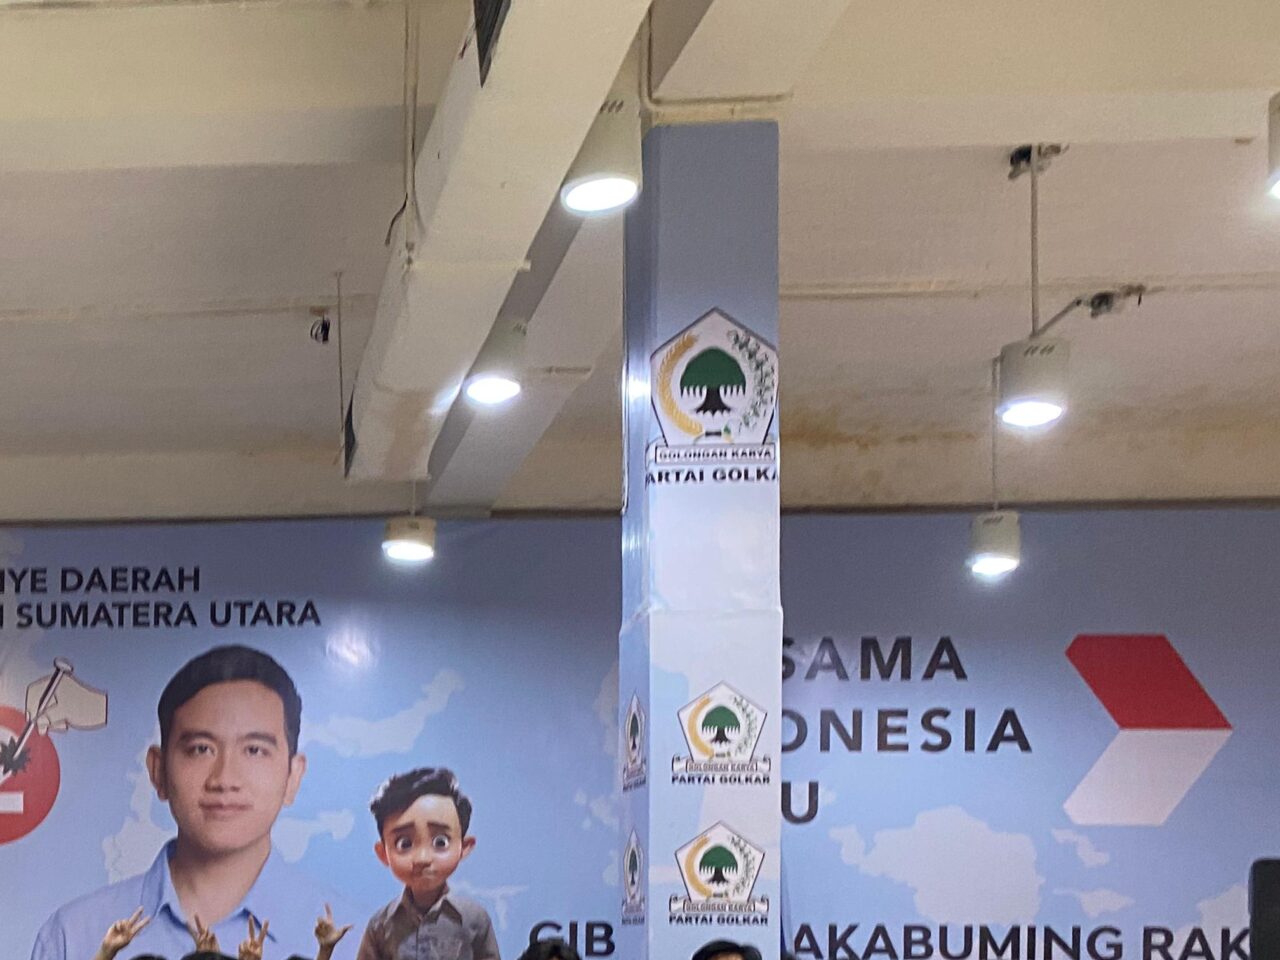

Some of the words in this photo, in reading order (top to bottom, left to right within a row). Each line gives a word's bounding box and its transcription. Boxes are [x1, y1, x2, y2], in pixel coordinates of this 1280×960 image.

[731, 446, 771, 458] KARYA
[646, 469, 705, 485] ARTAI
[60, 566, 200, 594] DAERAH
[16, 600, 198, 629] SUMATERA
[209, 600, 322, 628] UTARA
[671, 774, 716, 785] PARTAI
[719, 774, 770, 785] GOLKAR
[668, 914, 713, 926] PARTAI
[716, 914, 768, 926] GOLKAR
